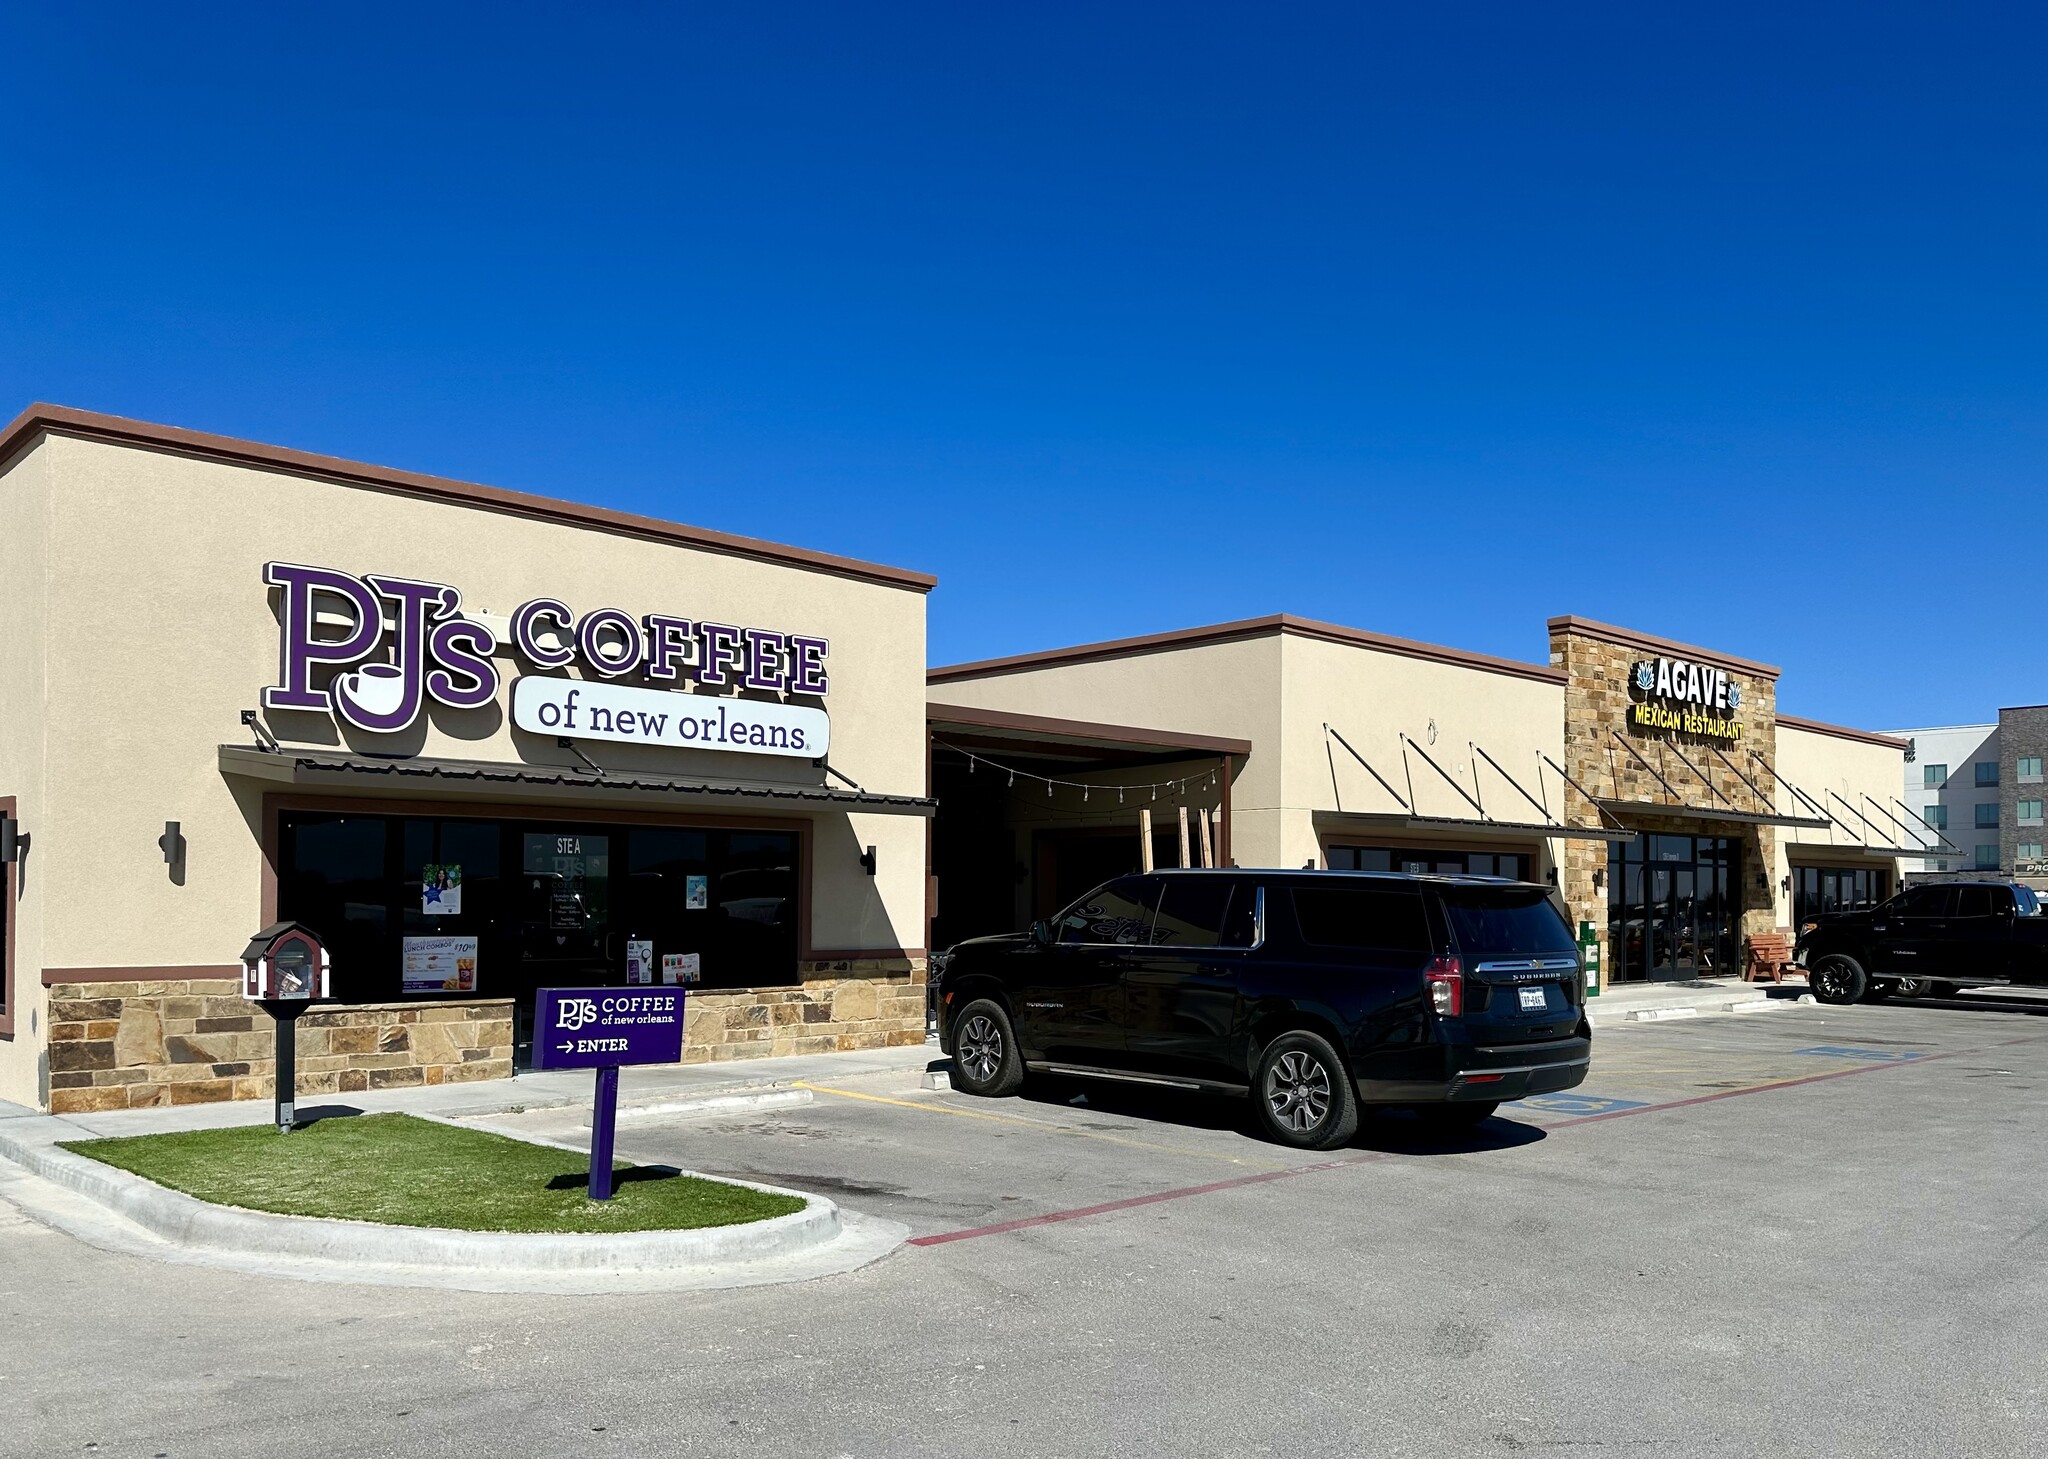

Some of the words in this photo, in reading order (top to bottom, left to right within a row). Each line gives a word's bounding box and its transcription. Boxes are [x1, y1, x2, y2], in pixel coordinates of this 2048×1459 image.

[261, 562, 500, 733] PJ's
[513, 598, 830, 697] COFFEE
[1656, 657, 1727, 709] AGAVE
[538, 691, 580, 729] of
[589, 707, 669, 738] new
[1635, 705, 1681, 731] MEXICAN
[1684, 714, 1744, 740] RESTAURANT
[557, 838, 573, 854] STE
[574, 838, 581, 854] A
[404, 945, 426, 953] LUNCH
[426, 942, 452, 950] COMBOS
[1512, 972, 1561, 981] SUBURBAN
[555, 999, 598, 1031] PJ's
[602, 997, 675, 1012] COFFEE
[601, 1015, 613, 1025] of
[614, 1017, 635, 1025] new
[577, 1039, 629, 1053] ENTER
